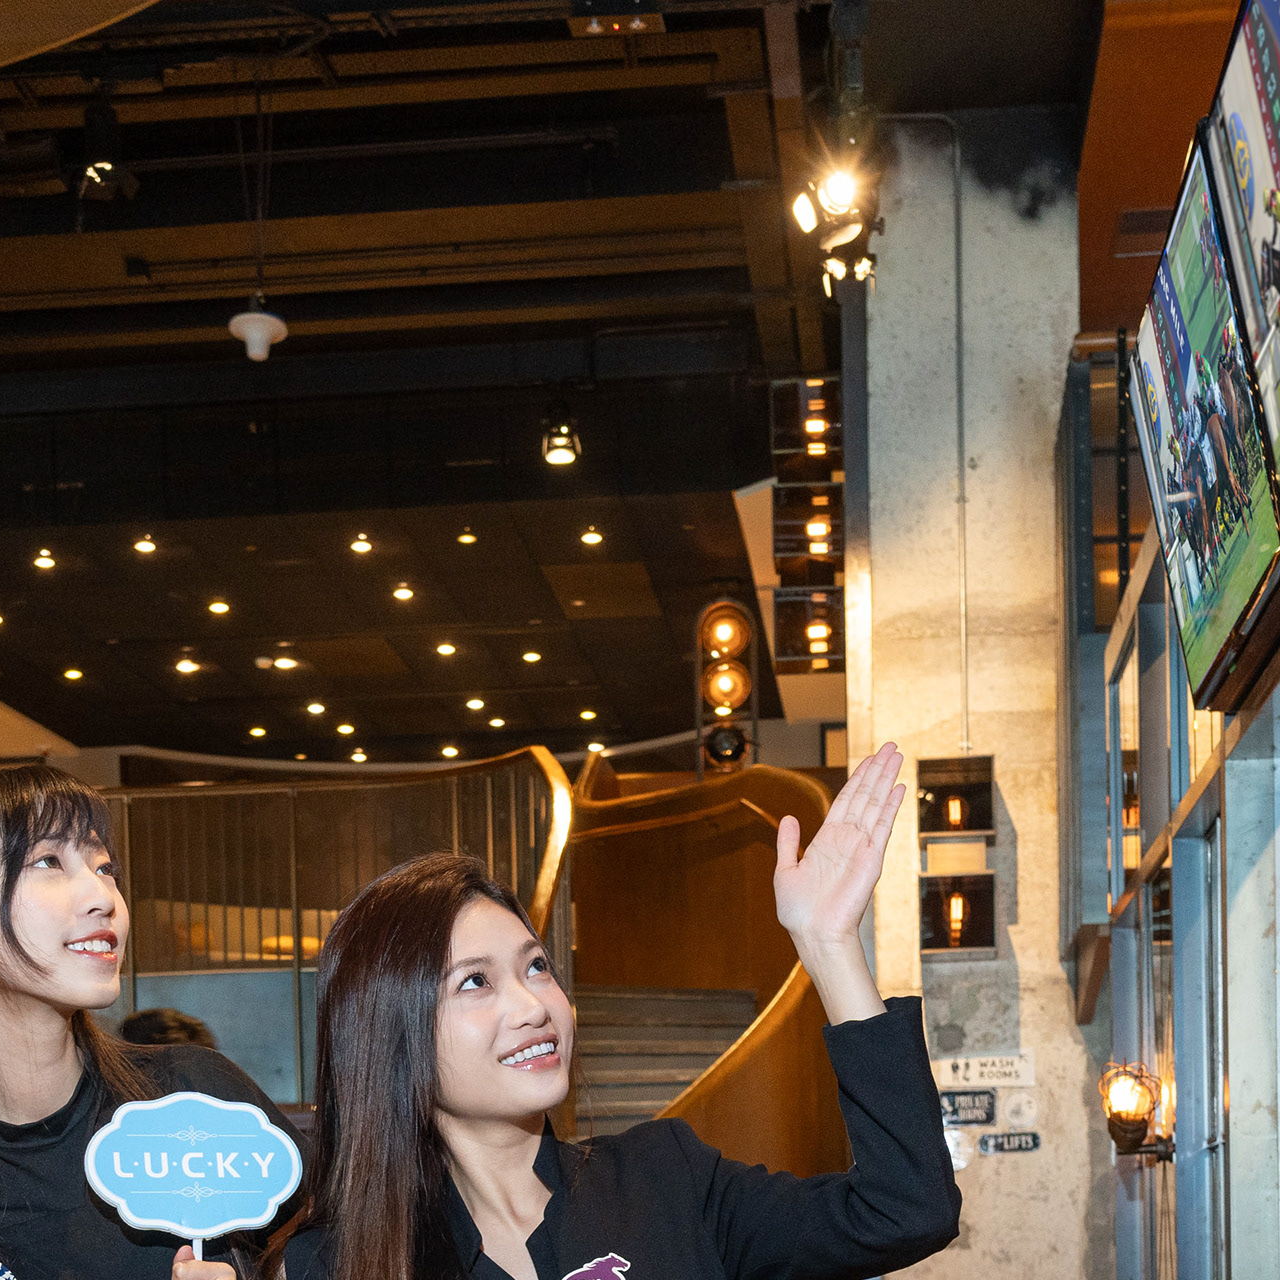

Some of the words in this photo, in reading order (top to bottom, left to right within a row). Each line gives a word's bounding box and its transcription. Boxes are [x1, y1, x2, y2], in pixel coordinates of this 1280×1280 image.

[979, 1060, 1014, 1068] WASH
[979, 1070, 1020, 1079] ROOMS
[1003, 1134, 1034, 1150] LIFTS
